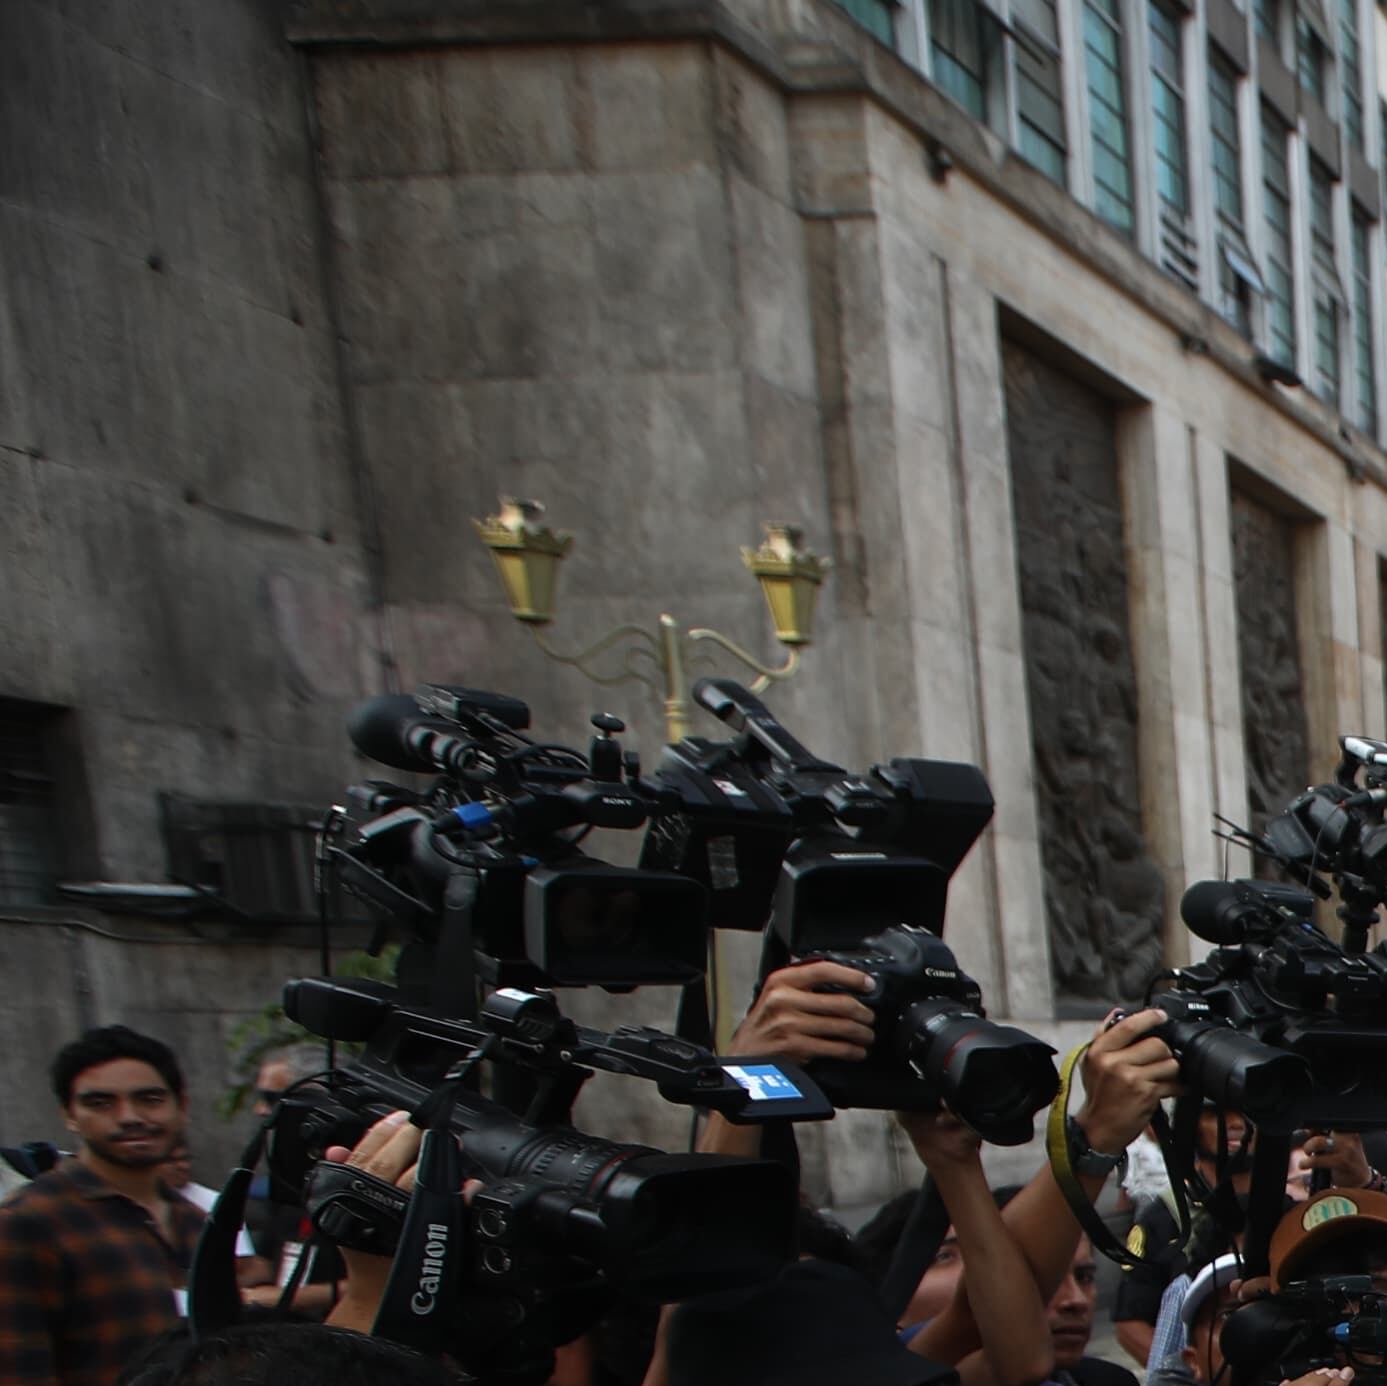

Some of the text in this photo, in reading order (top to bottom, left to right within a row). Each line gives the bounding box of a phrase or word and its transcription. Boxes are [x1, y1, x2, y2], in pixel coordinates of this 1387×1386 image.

[924, 967, 956, 978] Canon
[352, 1179, 407, 1211] Canon
[410, 1223, 449, 1316] Canon
